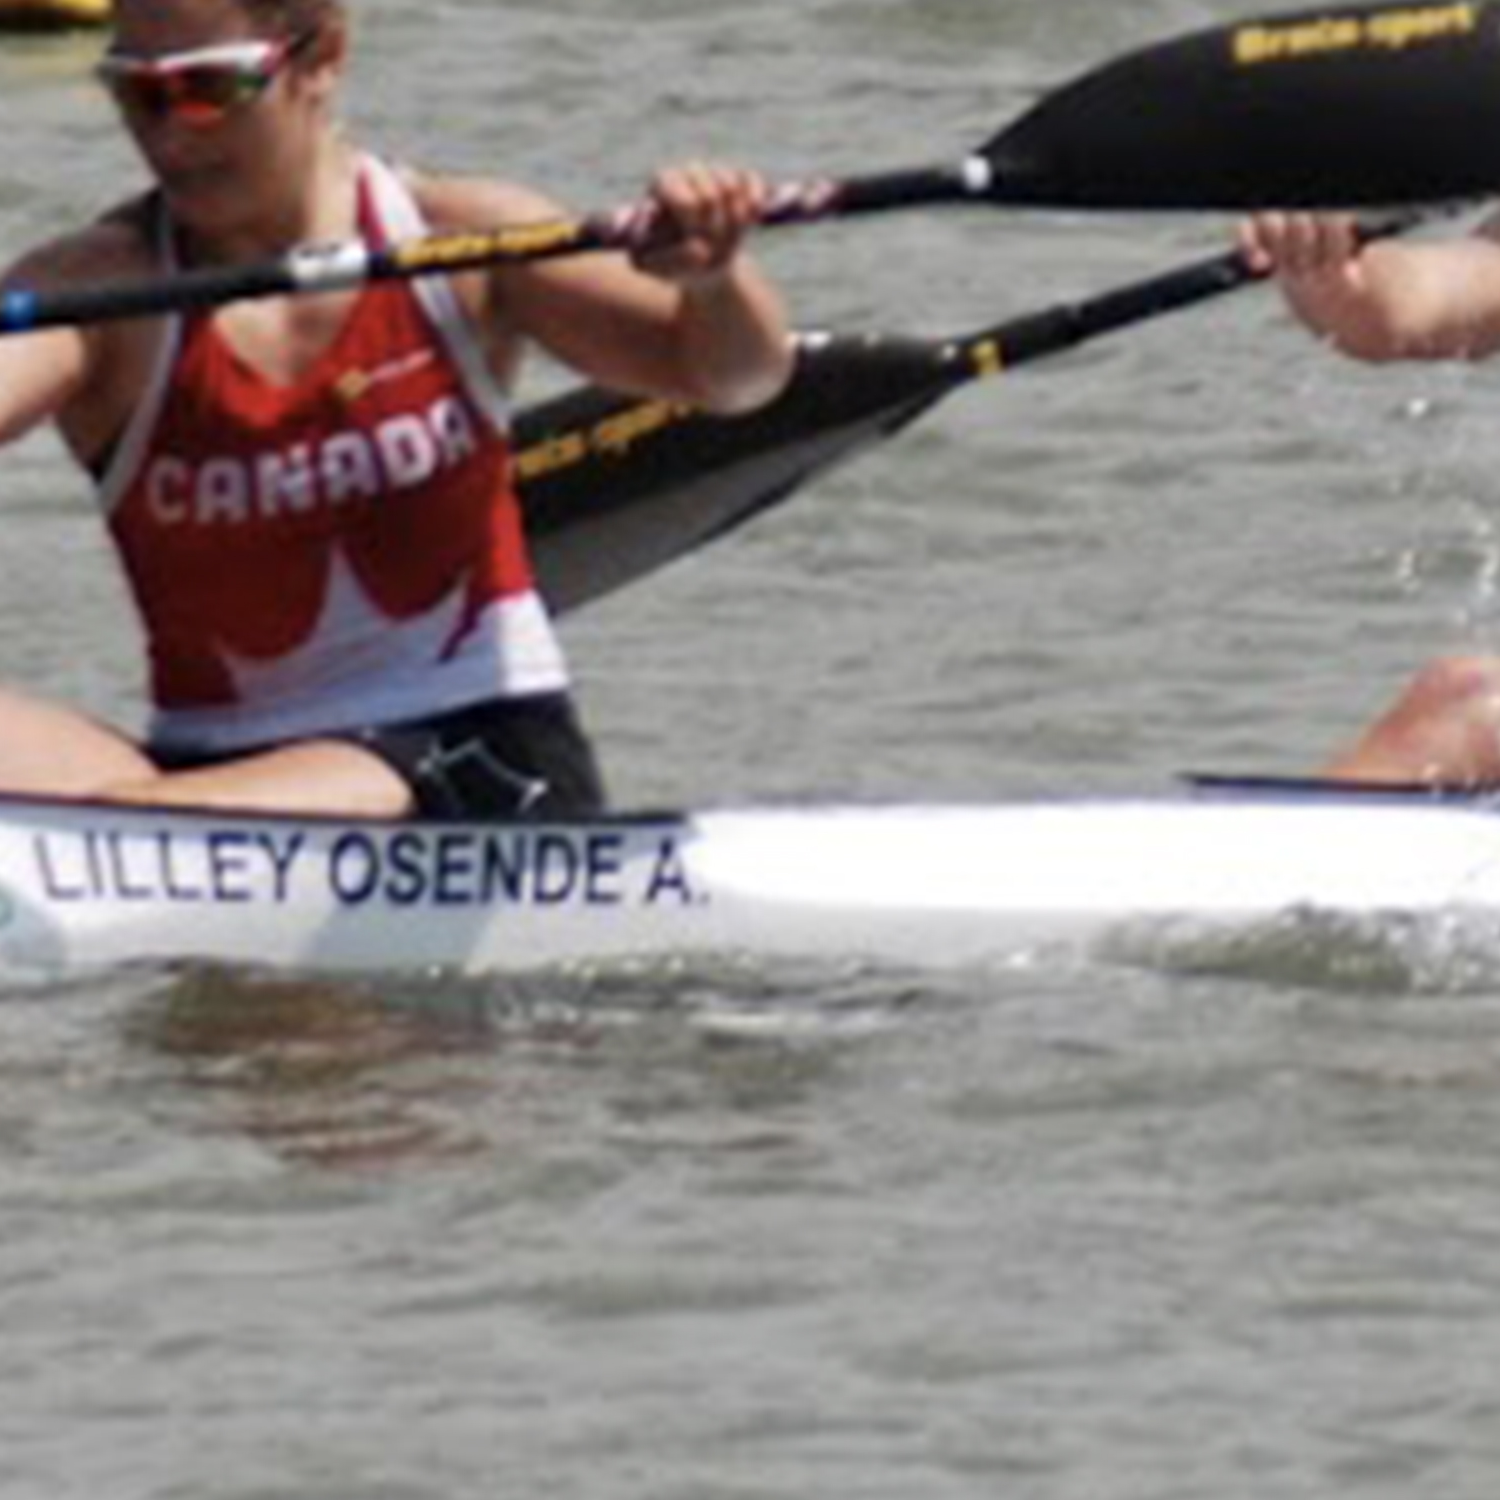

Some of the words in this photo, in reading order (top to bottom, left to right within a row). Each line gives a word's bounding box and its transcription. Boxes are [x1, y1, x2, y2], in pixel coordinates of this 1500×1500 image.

[145, 397, 478, 524] CANADA
[36, 830, 305, 902] LILLEY
[328, 832, 621, 902] OSENDE
